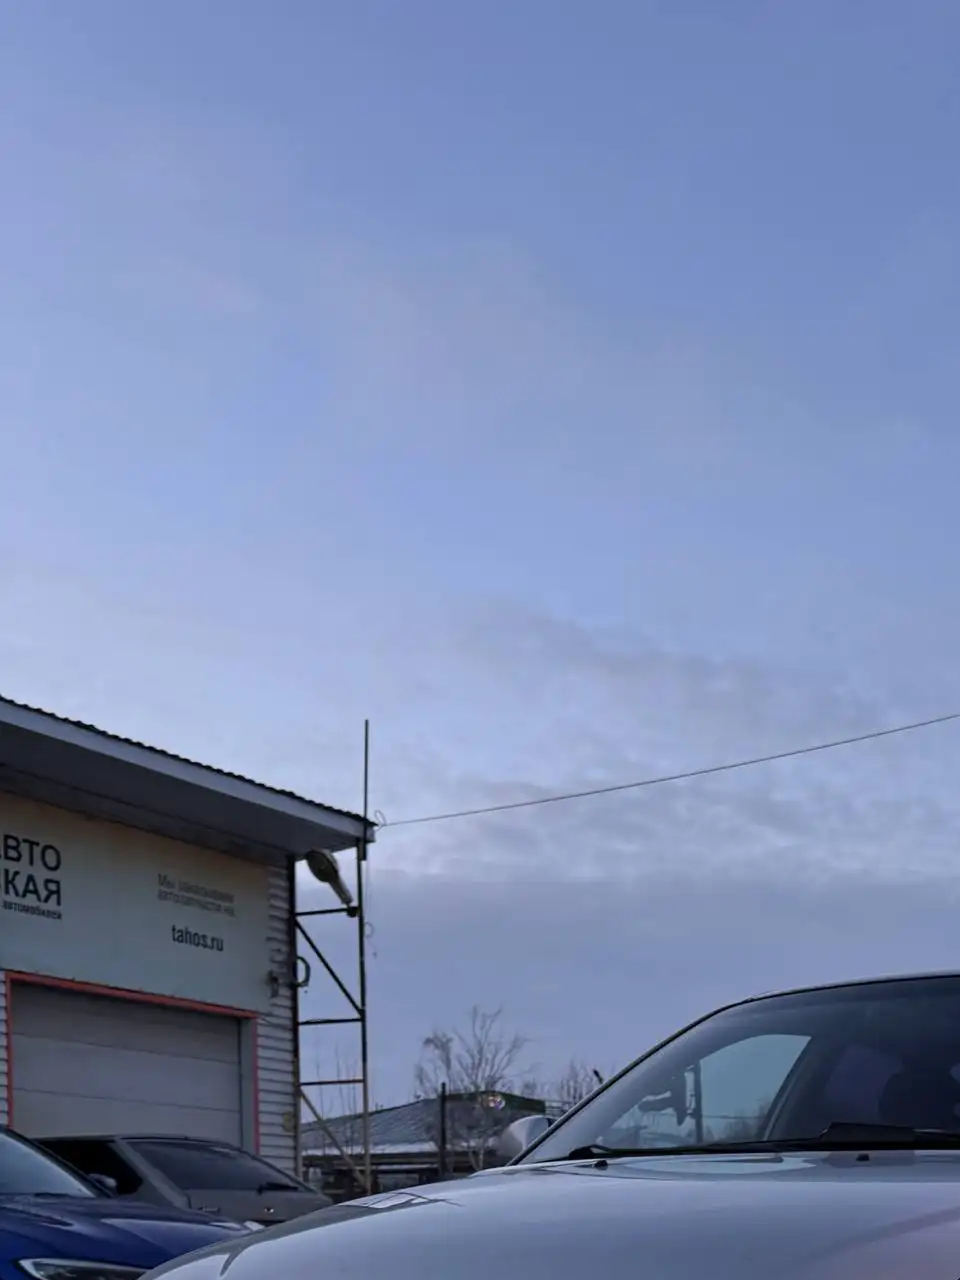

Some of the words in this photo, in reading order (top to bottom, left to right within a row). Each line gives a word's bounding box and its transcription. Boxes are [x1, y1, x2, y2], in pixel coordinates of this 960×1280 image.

[0, 834, 62, 872] ВТО
[0, 867, 62, 907] КАЯ
[171, 924, 224, 952] tahos.ru
